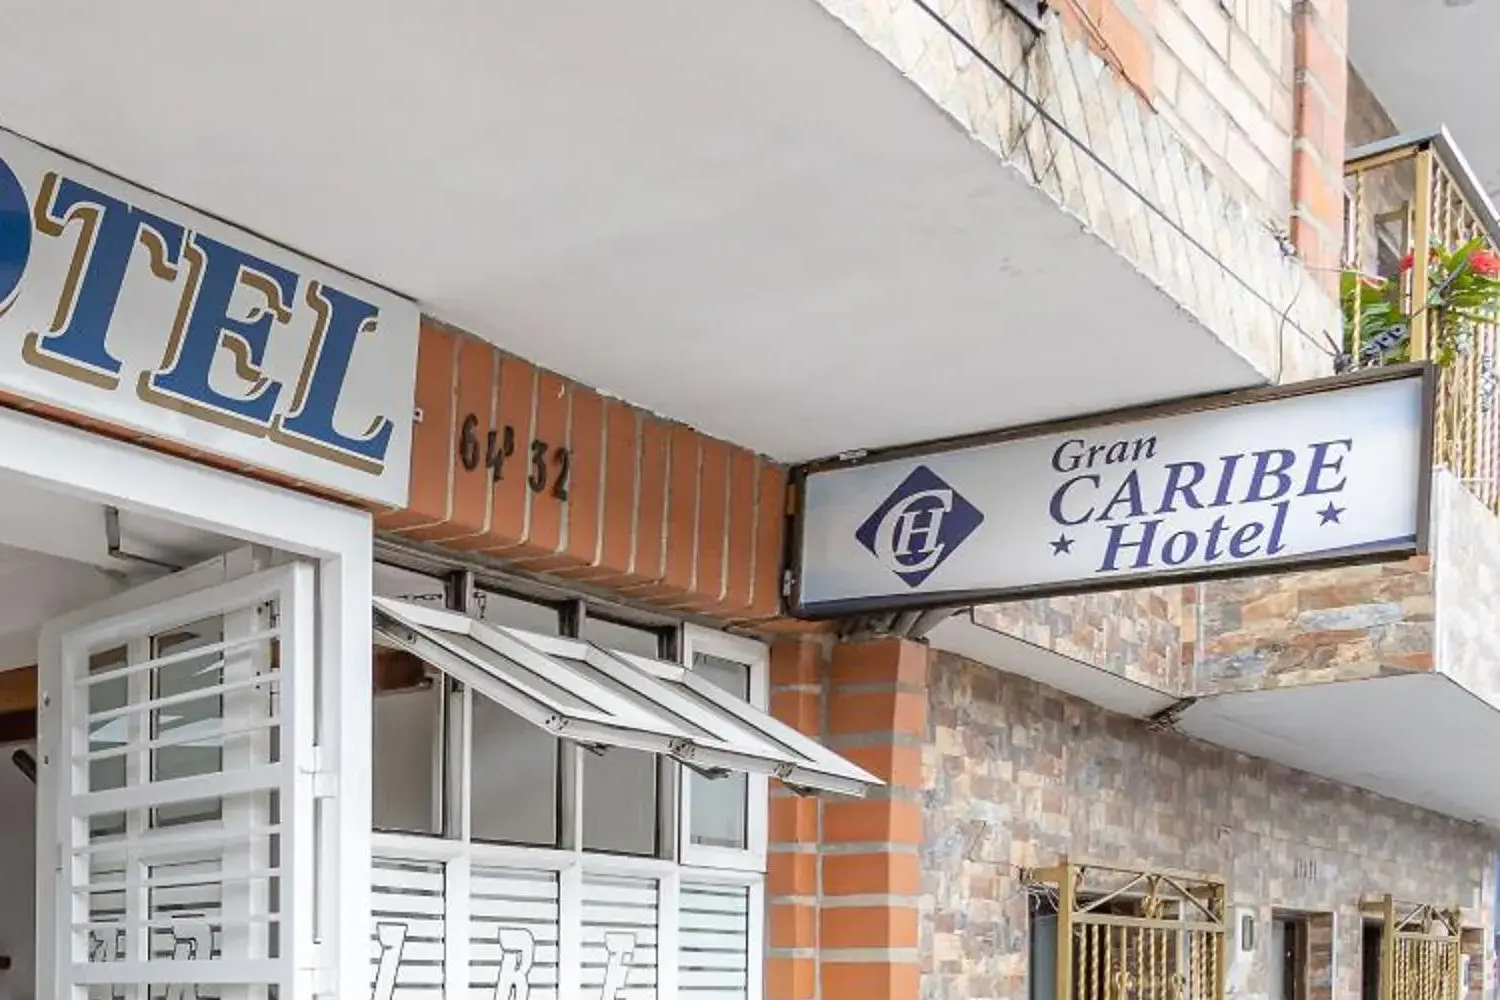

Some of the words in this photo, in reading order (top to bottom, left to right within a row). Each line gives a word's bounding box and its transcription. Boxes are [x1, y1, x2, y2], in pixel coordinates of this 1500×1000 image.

[1049, 438, 1354, 526] CARIBE
[1052, 434, 1157, 473] Gran
[1096, 502, 1287, 573] Hotel
